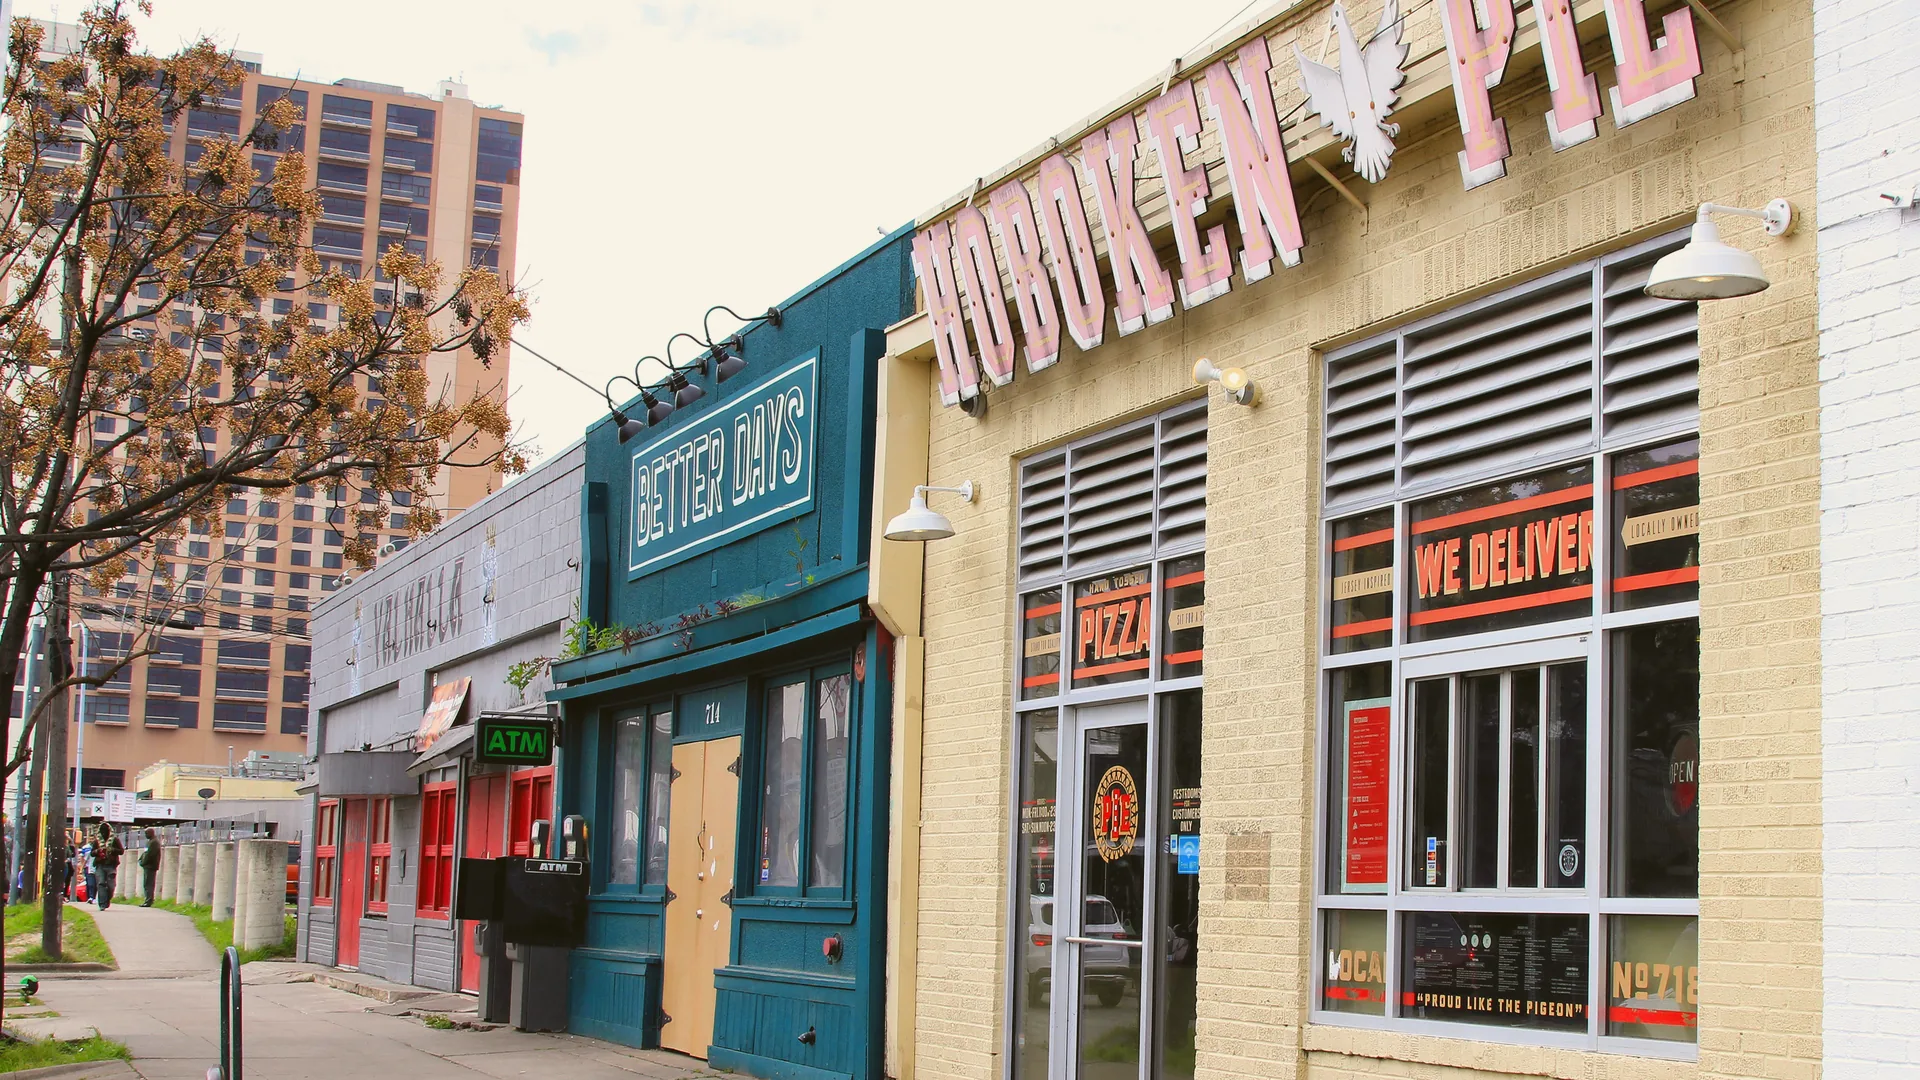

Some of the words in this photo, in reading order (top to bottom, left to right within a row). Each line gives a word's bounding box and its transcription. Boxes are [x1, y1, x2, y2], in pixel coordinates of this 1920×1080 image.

[911, 35, 1307, 407] HOBOKEN
[635, 427, 725, 547] BETTER
[731, 385, 804, 507] DAYS
[1631, 518, 1666, 539] LOCALLY
[1670, 512, 1699, 531] OWNED
[1414, 537, 1461, 599] WE
[1469, 509, 1593, 591] DELIVER
[1089, 580, 1110, 594] HAND
[1113, 571, 1145, 588] TOSSED
[1341, 579, 1361, 594] JERSEY
[1363, 573, 1391, 590] INSPIRED
[374, 556, 465, 669] VALHALLA
[1078, 597, 1151, 663] PIZZA
[705, 702, 721, 725] 714
[488, 730, 543, 754] ATM
[1669, 760, 1694, 784] OPEN
[1101, 788, 1131, 842] PIE
[1180, 821, 1193, 832] ONLY
[539, 862, 568, 872] ATM
[1467, 996, 1492, 1011] LIKE
[1498, 998, 1521, 1014] THE
